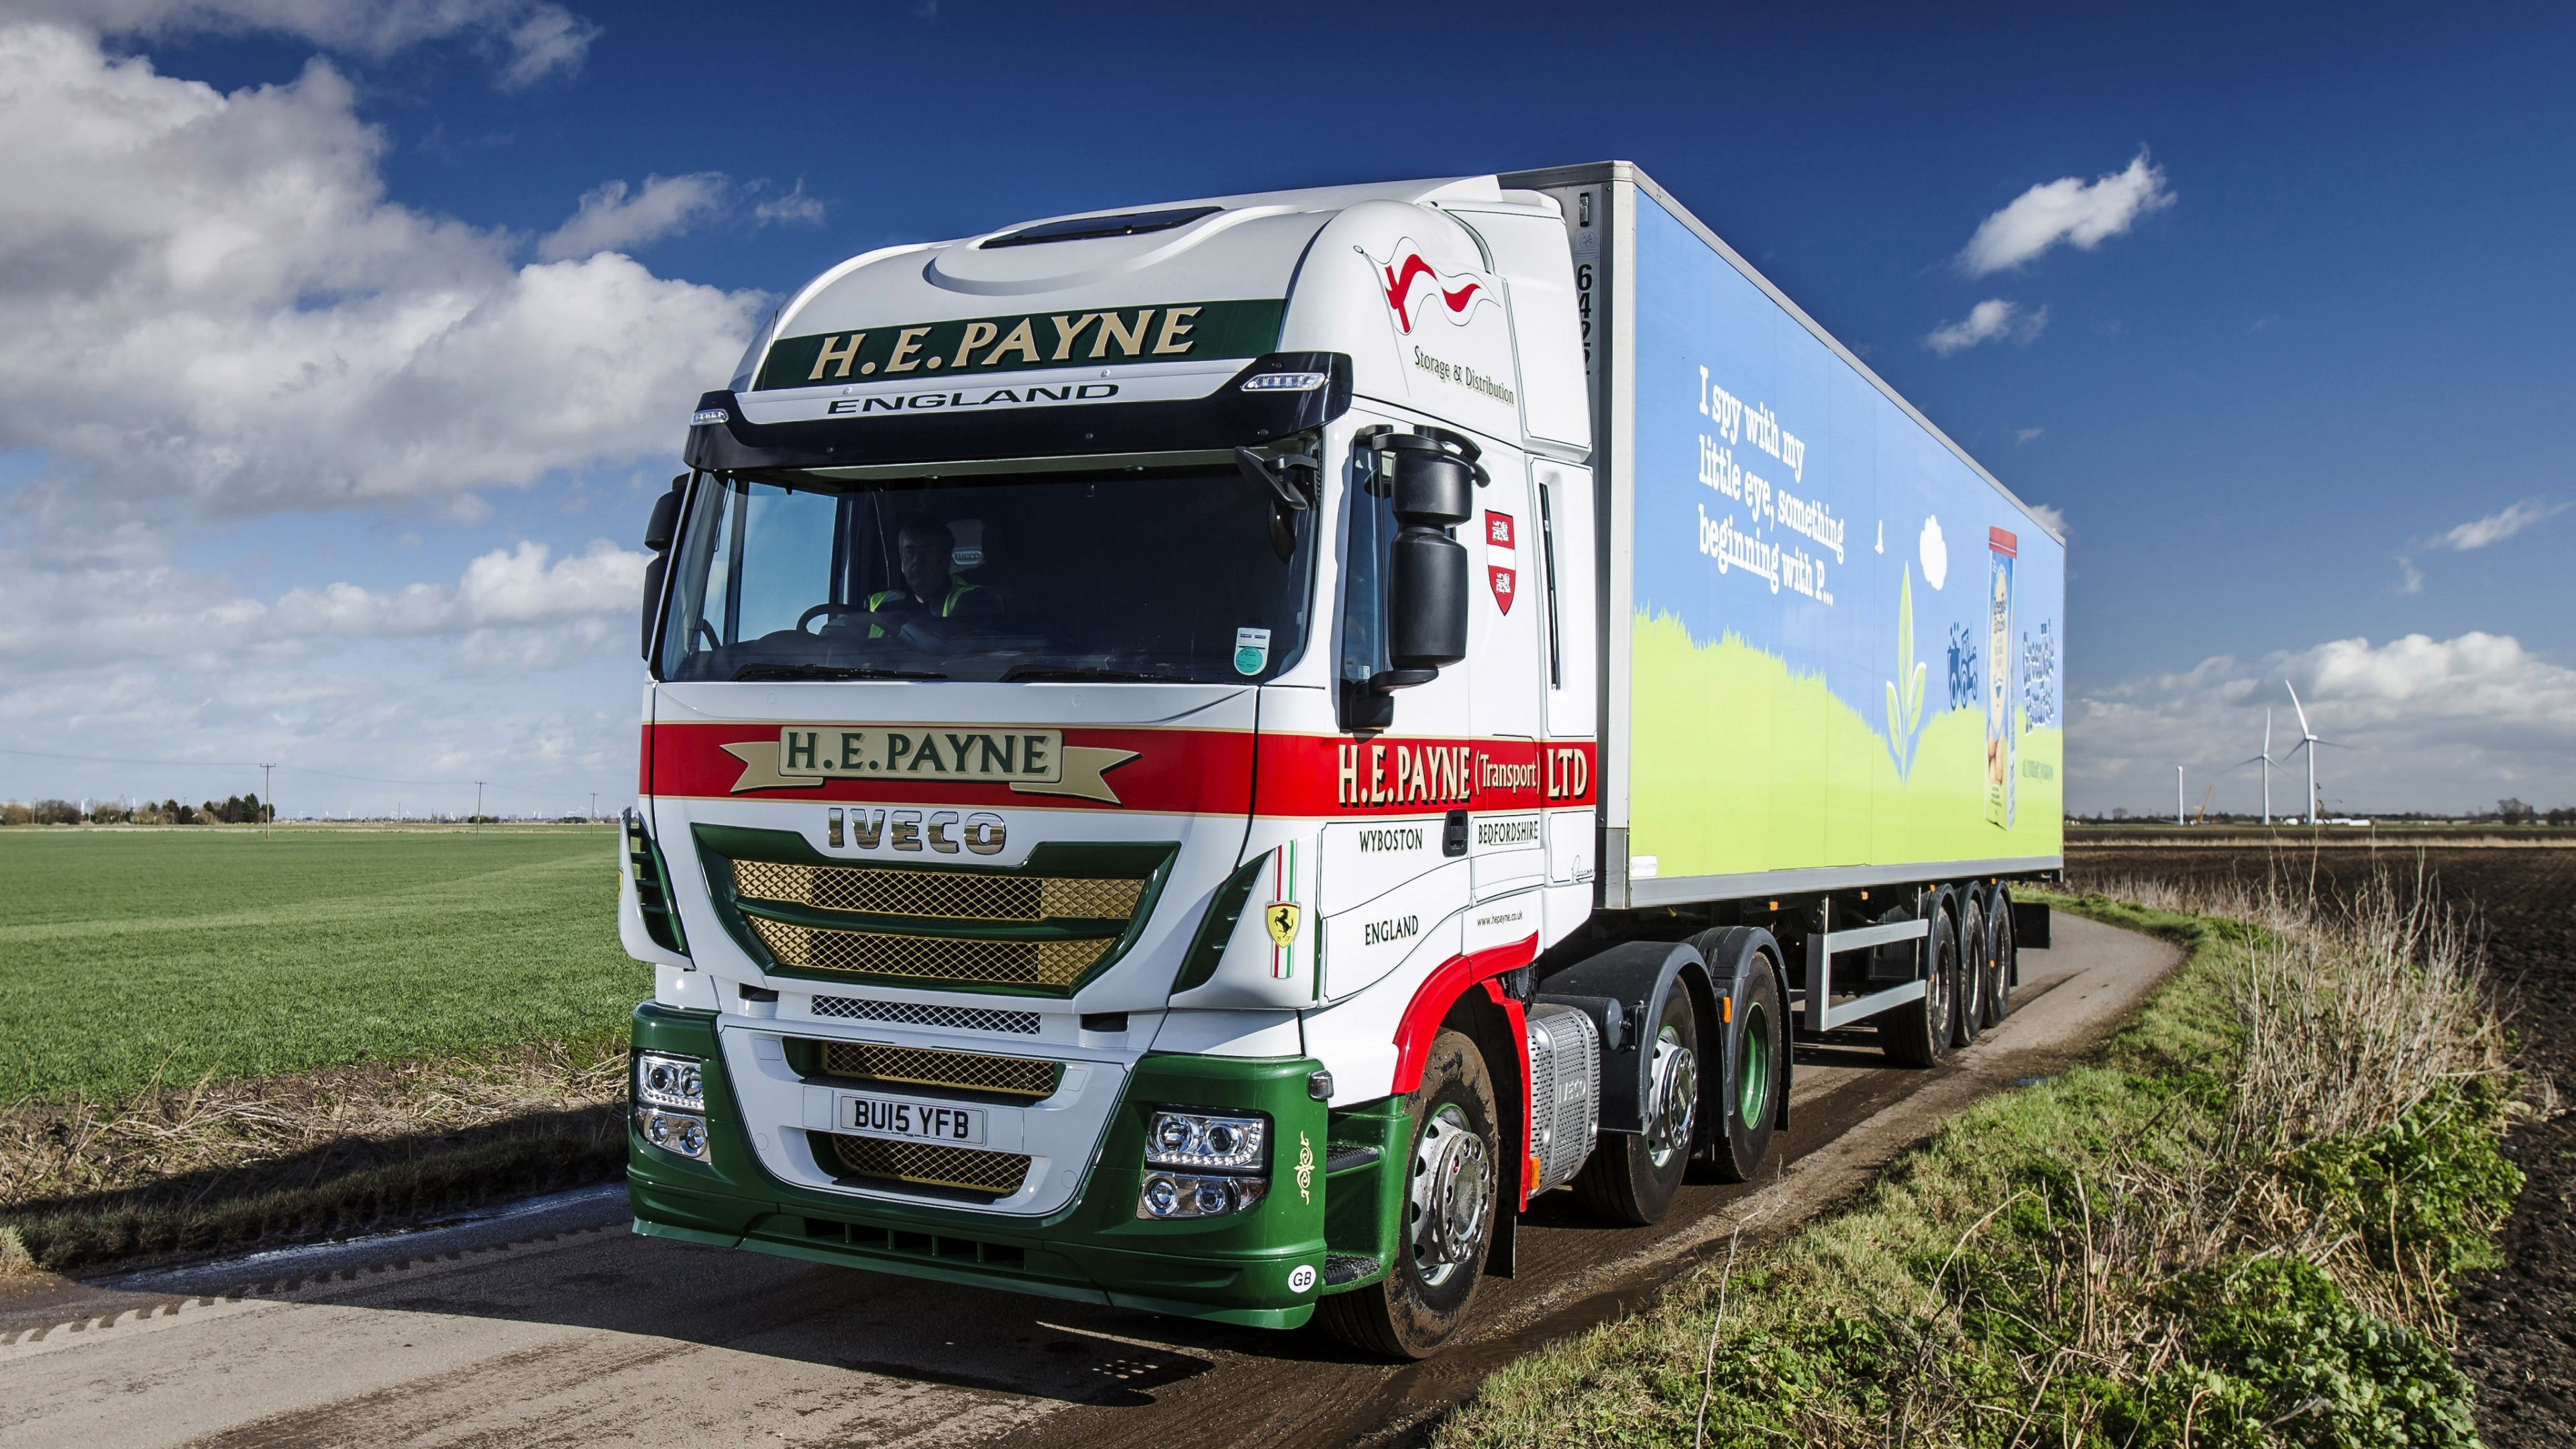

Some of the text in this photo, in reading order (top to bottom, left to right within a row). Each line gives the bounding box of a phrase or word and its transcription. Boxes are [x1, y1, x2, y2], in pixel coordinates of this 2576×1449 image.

[808, 306, 1206, 380] H.E.PAYNE
[1414, 345, 1515, 405] Storage & Distribution
[827, 384, 1120, 415] ENGLAND
[1699, 364, 1805, 483] I spy with my
[1699, 433, 1845, 566] little eye, something
[1698, 502, 1780, 595] beginning
[1782, 545, 1813, 598] with
[786, 731, 1051, 775] H.E.PAYNE
[1338, 744, 1589, 804] H.E.PAYNE (Transport) LTD
[828, 808, 1006, 855] IVECO
[1359, 828, 1423, 853] WYBOSTON
[1479, 820, 1538, 845] BEDFORDSHIRE
[1364, 915, 1419, 946] ENGLAND
[1477, 910, 1523, 926] www.hepayne.co.uk
[1558, 1075, 1587, 1104] IVECO
[855, 1099, 969, 1139] BU15 YFB
[1293, 1271, 1311, 1286] GB
